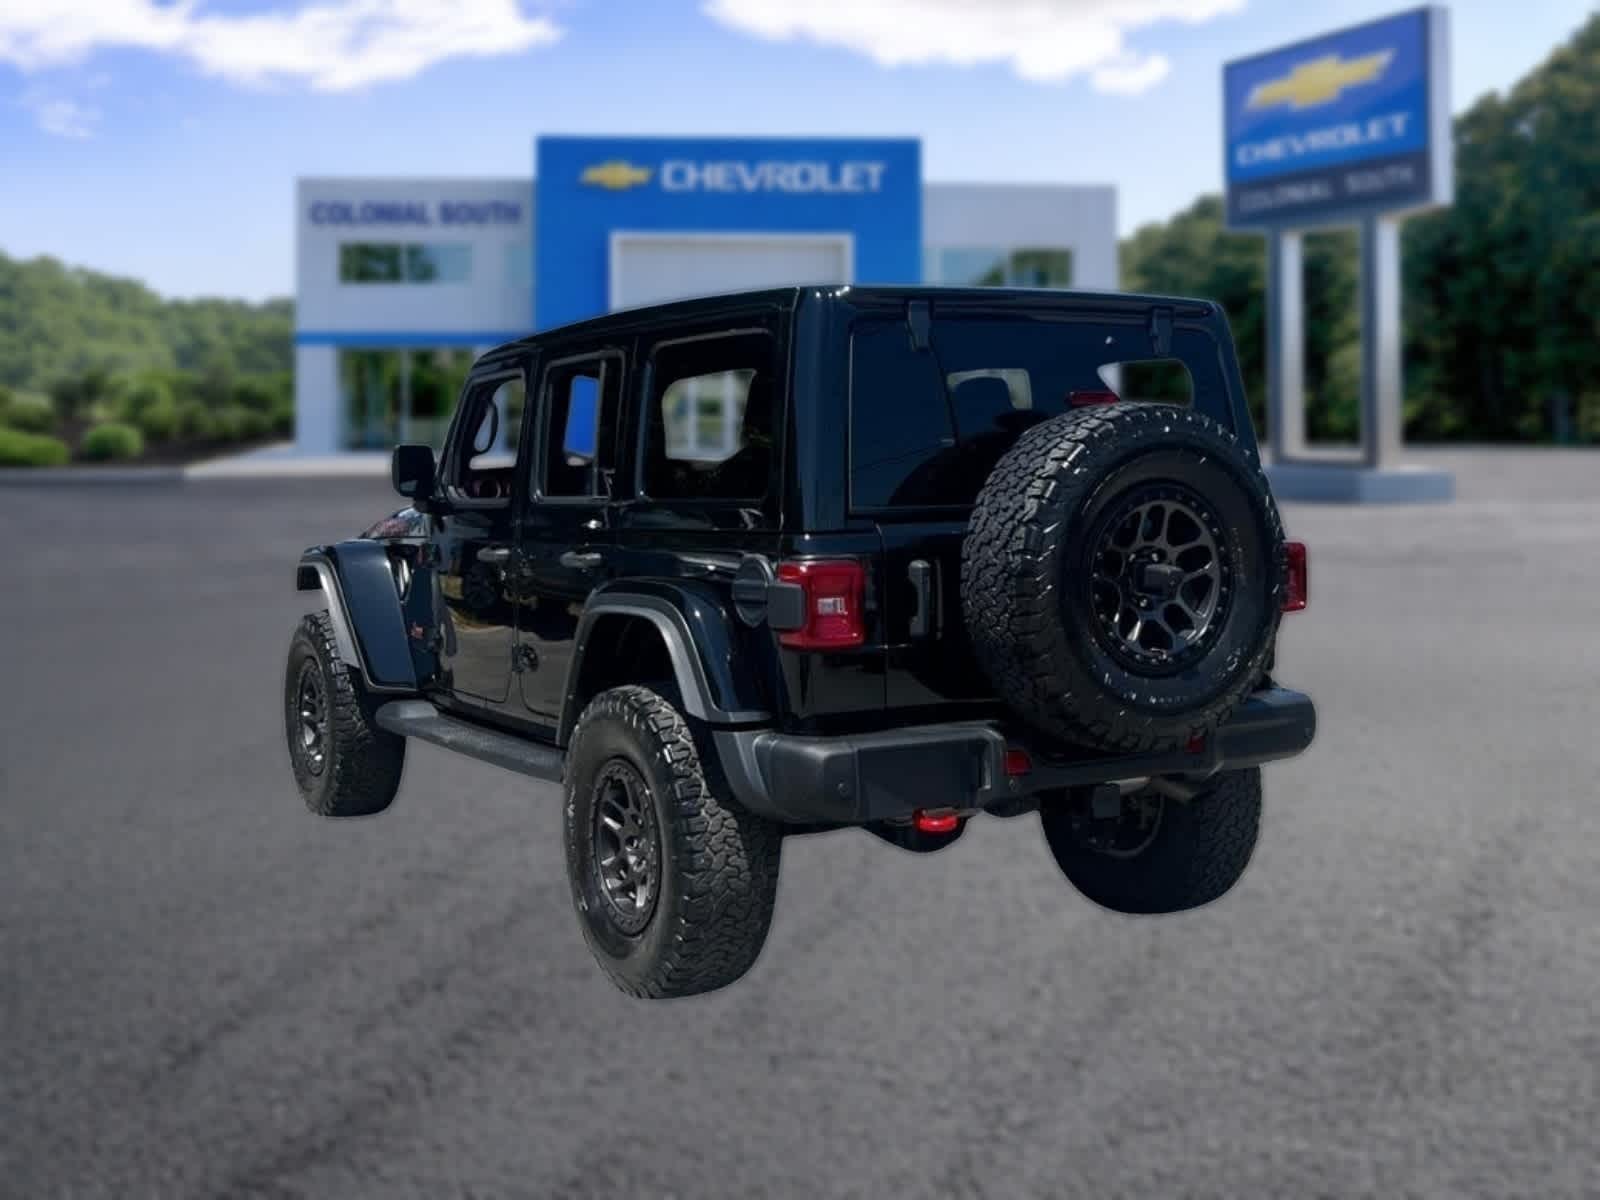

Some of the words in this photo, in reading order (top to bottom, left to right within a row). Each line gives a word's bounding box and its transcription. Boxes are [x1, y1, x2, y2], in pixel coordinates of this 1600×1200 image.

[1236, 112, 1410, 167] CHEVROLET
[660, 160, 885, 192] CHEVROLET
[309, 201, 431, 226] COLONIAL
[439, 201, 522, 226] SOUTH
